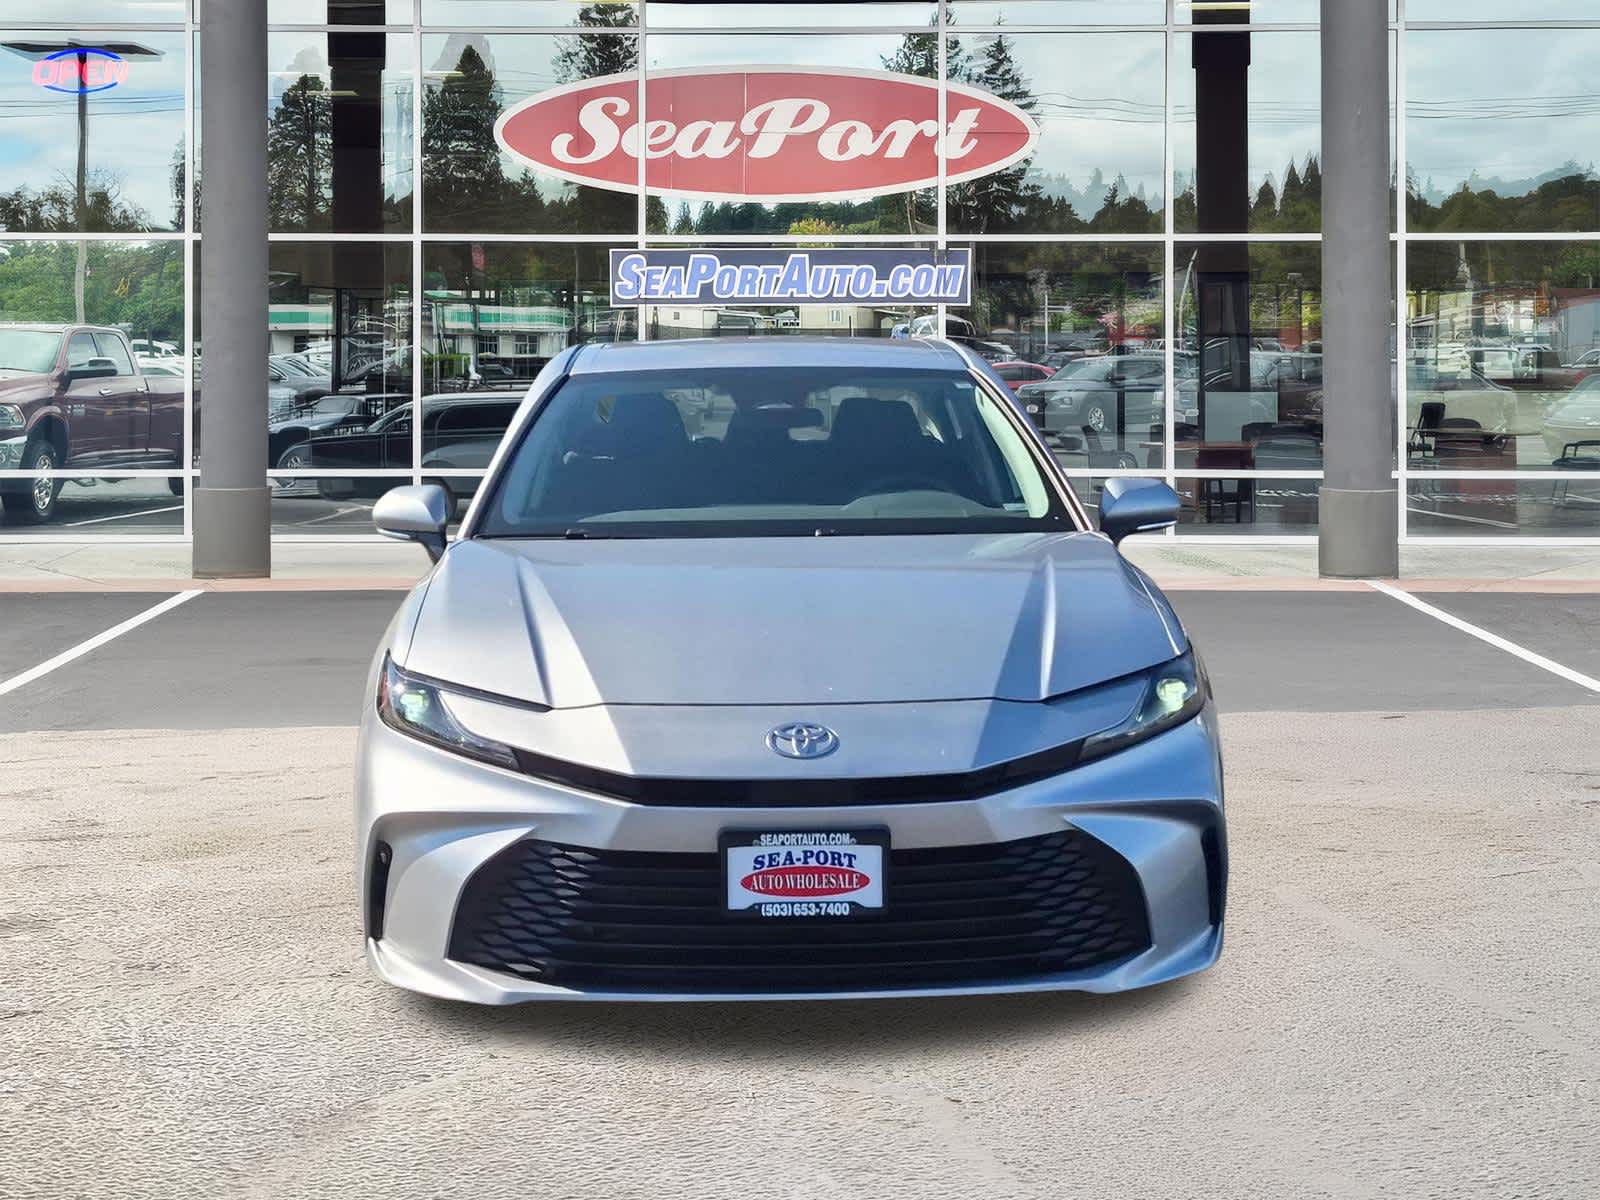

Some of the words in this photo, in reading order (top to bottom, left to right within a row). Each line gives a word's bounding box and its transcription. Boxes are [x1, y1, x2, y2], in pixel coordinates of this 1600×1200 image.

[34, 59, 128, 85] OPEN
[551, 97, 982, 163] SeaPort
[760, 833, 850, 846] SEAPORTAUTO.COM
[753, 850, 857, 870] SEA-PORT
[750, 874, 783, 891] AUTO
[785, 873, 861, 889] WHOLESALE
